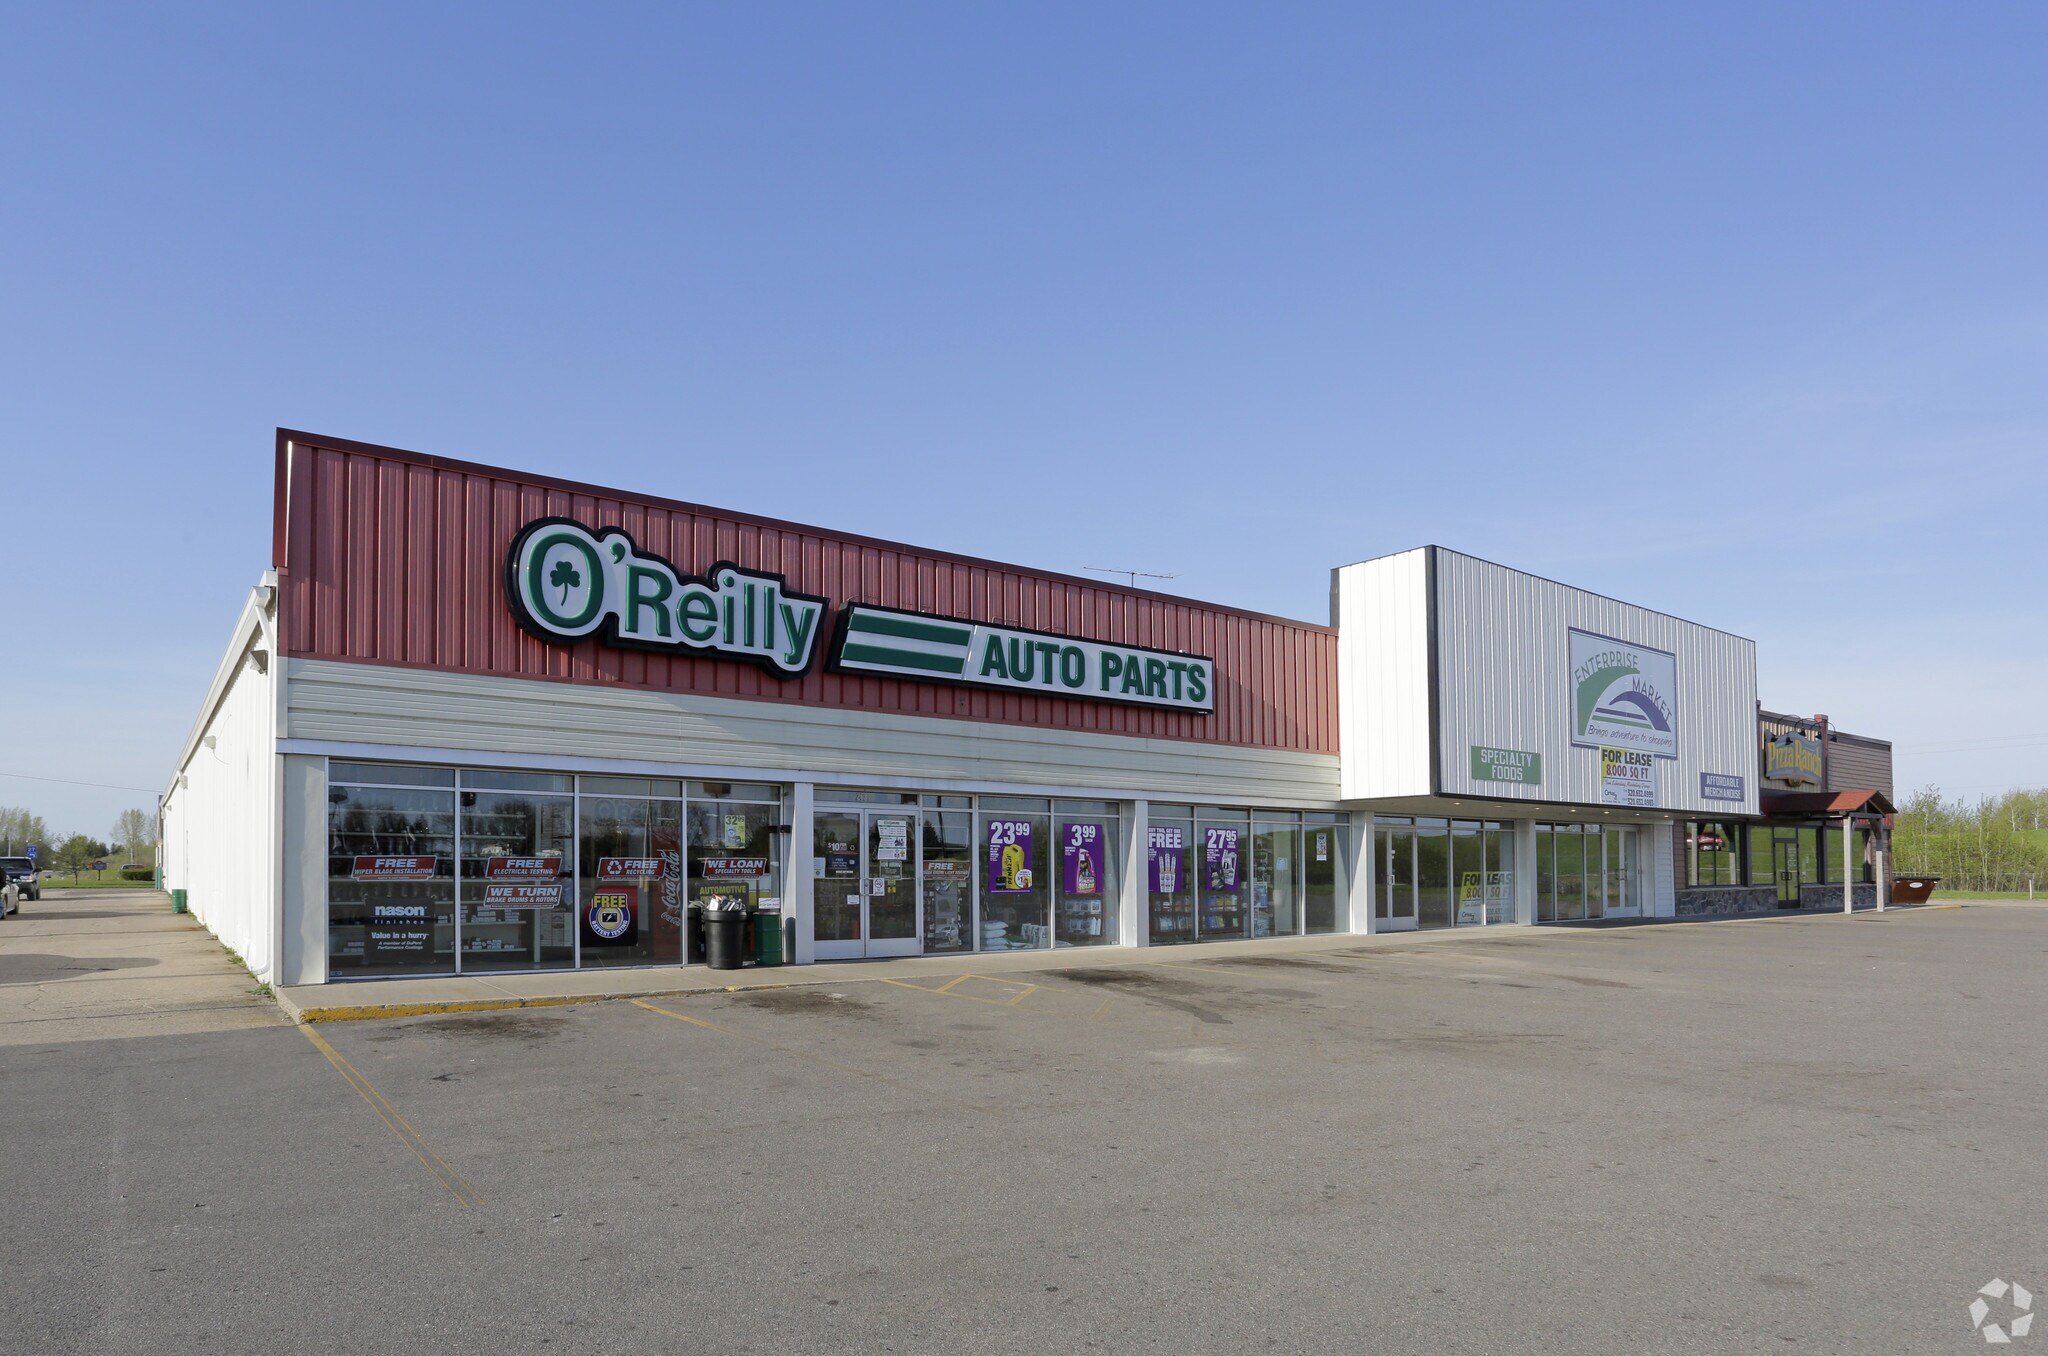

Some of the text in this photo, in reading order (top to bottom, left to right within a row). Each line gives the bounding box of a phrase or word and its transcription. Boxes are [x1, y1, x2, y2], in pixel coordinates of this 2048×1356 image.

[527, 532, 816, 665] O'Reilly
[979, 633, 1207, 702] AUTO PARTS
[1574, 651, 1639, 686] ENTERPRISE
[1632, 675, 1673, 722] MARKET
[1588, 724, 1673, 748] Brings adventure to shopping
[1481, 749, 1533, 767] SPECIALTY
[1602, 749, 1652, 767] FOR LEASE
[1767, 740, 1822, 777] Pizza Ranch
[1491, 765, 1523, 781] FOODS
[1606, 764, 1649, 779] 8,000 SQ FT
[1706, 775, 1740, 788] AFFORDABLE
[1705, 787, 1742, 799] MERCHANDISE
[1148, 833, 1182, 849] FREE
[374, 858, 418, 868] FREE
[506, 859, 545, 868] FREE
[624, 860, 659, 869] FREE
[707, 860, 764, 868] WE LOAN
[928, 862, 954, 870] FREE
[1487, 872, 1512, 886] LEAS
[490, 887, 558, 896] WE TURN
[700, 885, 747, 895] AUTOMOTIVE
[593, 895, 626, 908] FREE
[375, 905, 425, 916] nason
[408, 932, 427, 940] hurry
